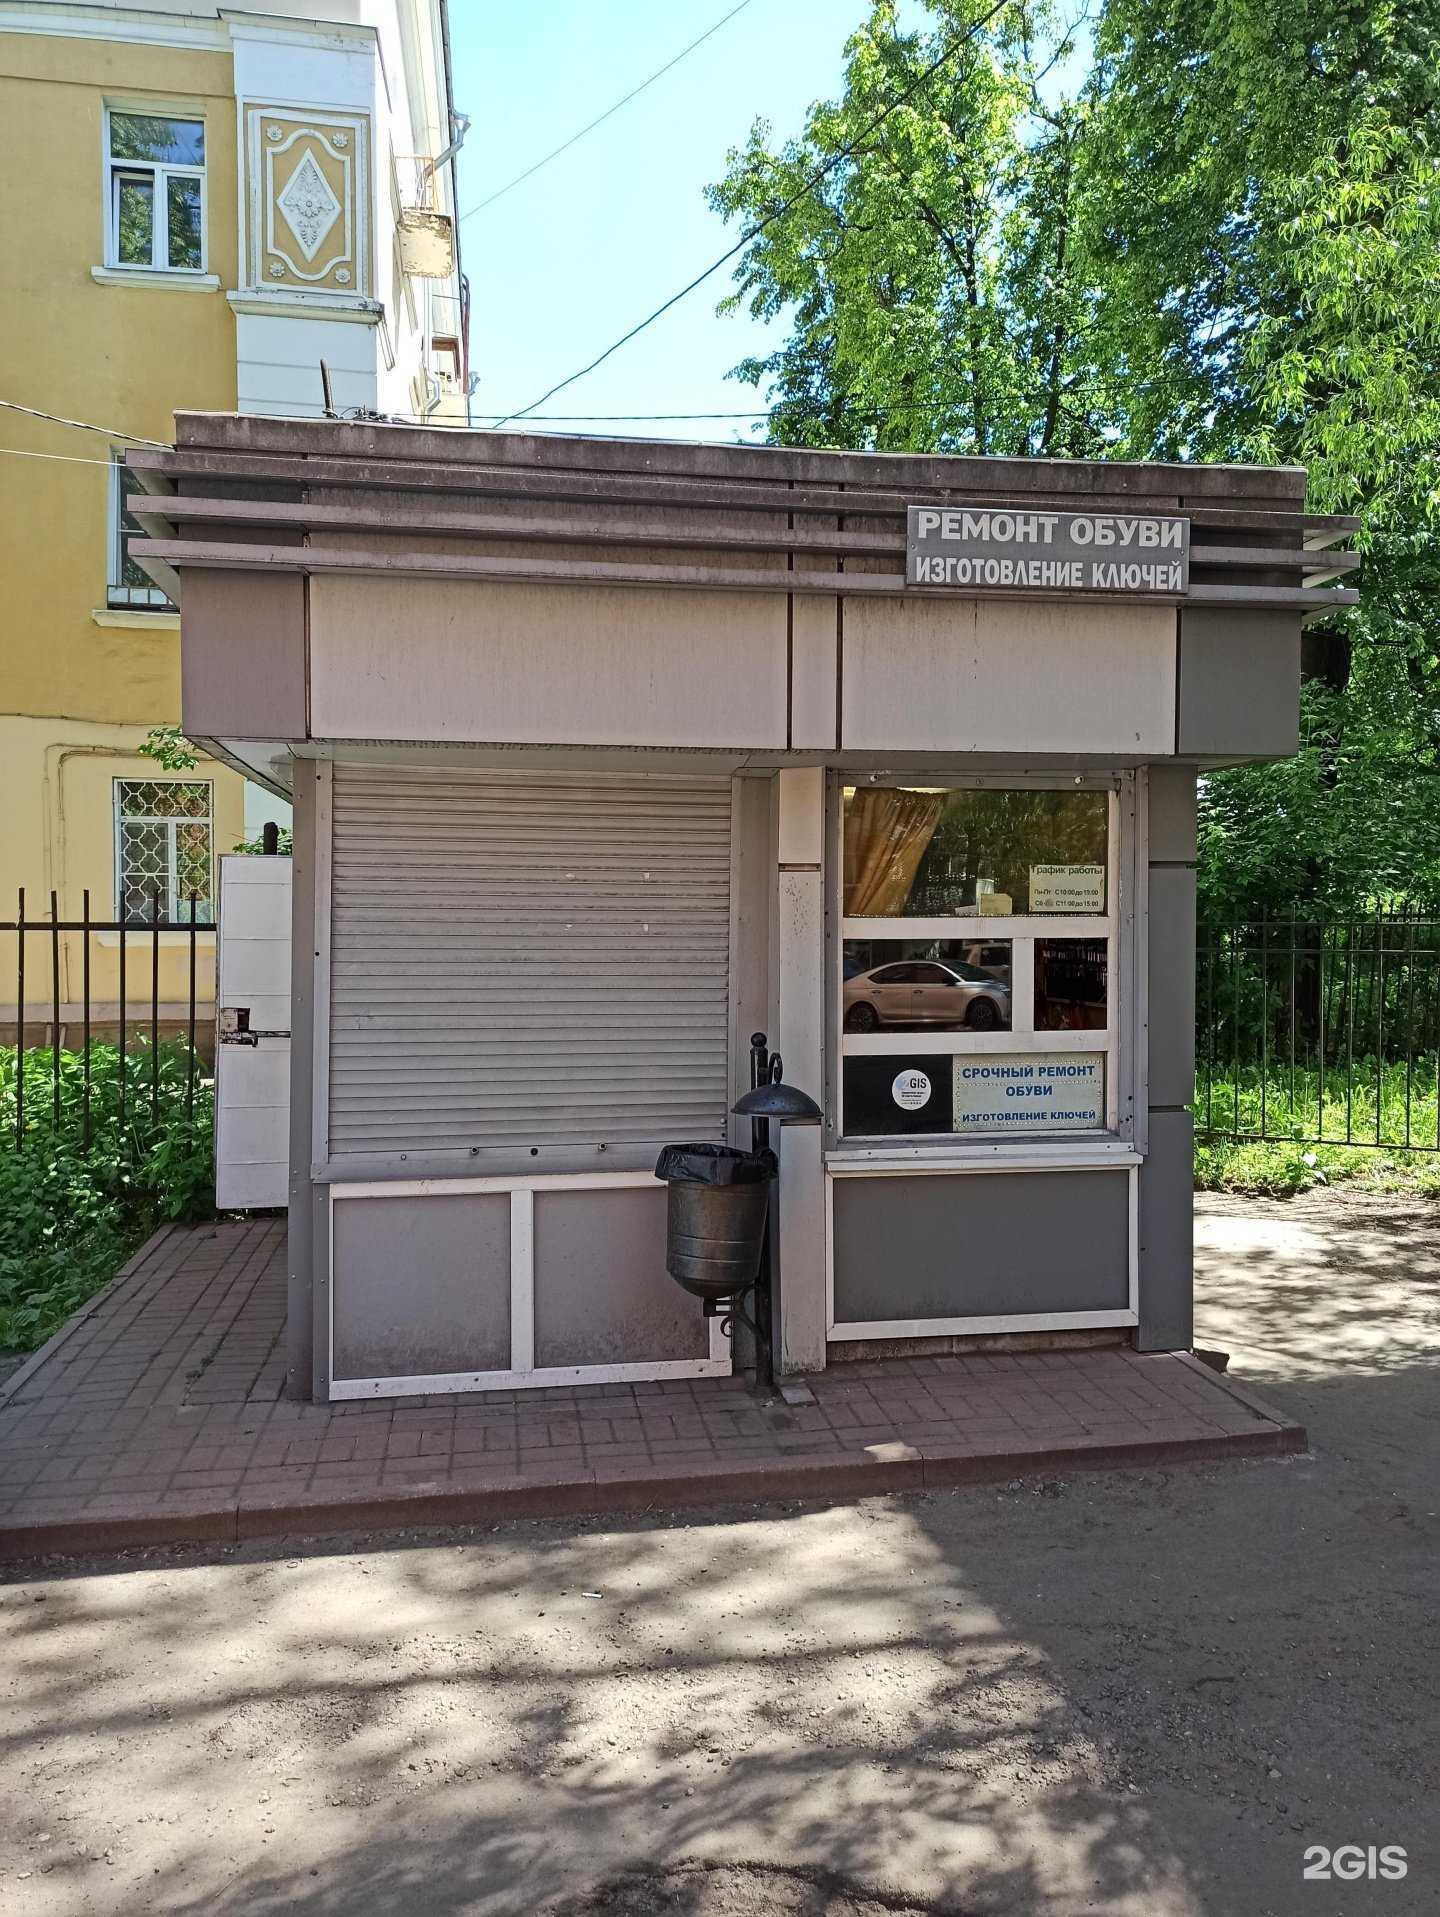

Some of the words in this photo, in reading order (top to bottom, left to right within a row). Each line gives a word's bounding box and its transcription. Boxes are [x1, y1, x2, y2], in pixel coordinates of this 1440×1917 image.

[918, 511, 1058, 543] РЕМОНТ
[1069, 517, 1183, 548] ОБУВИ
[915, 556, 1083, 587] ИЗГОТОВЛЕНИЕ
[1091, 560, 1182, 590] КЛЮЧЕЙ
[1068, 865, 1103, 876] работы
[962, 1065, 1034, 1079] СРОЧНЫЙ
[1038, 1065, 1095, 1077] РЕМОНТ
[1005, 1085, 1053, 1097] ОБУВИ
[962, 1111, 1048, 1122] ИЗГОТОВЛЕНИЕ
[1050, 1109, 1096, 1120] КЛЮЧЕЙ
